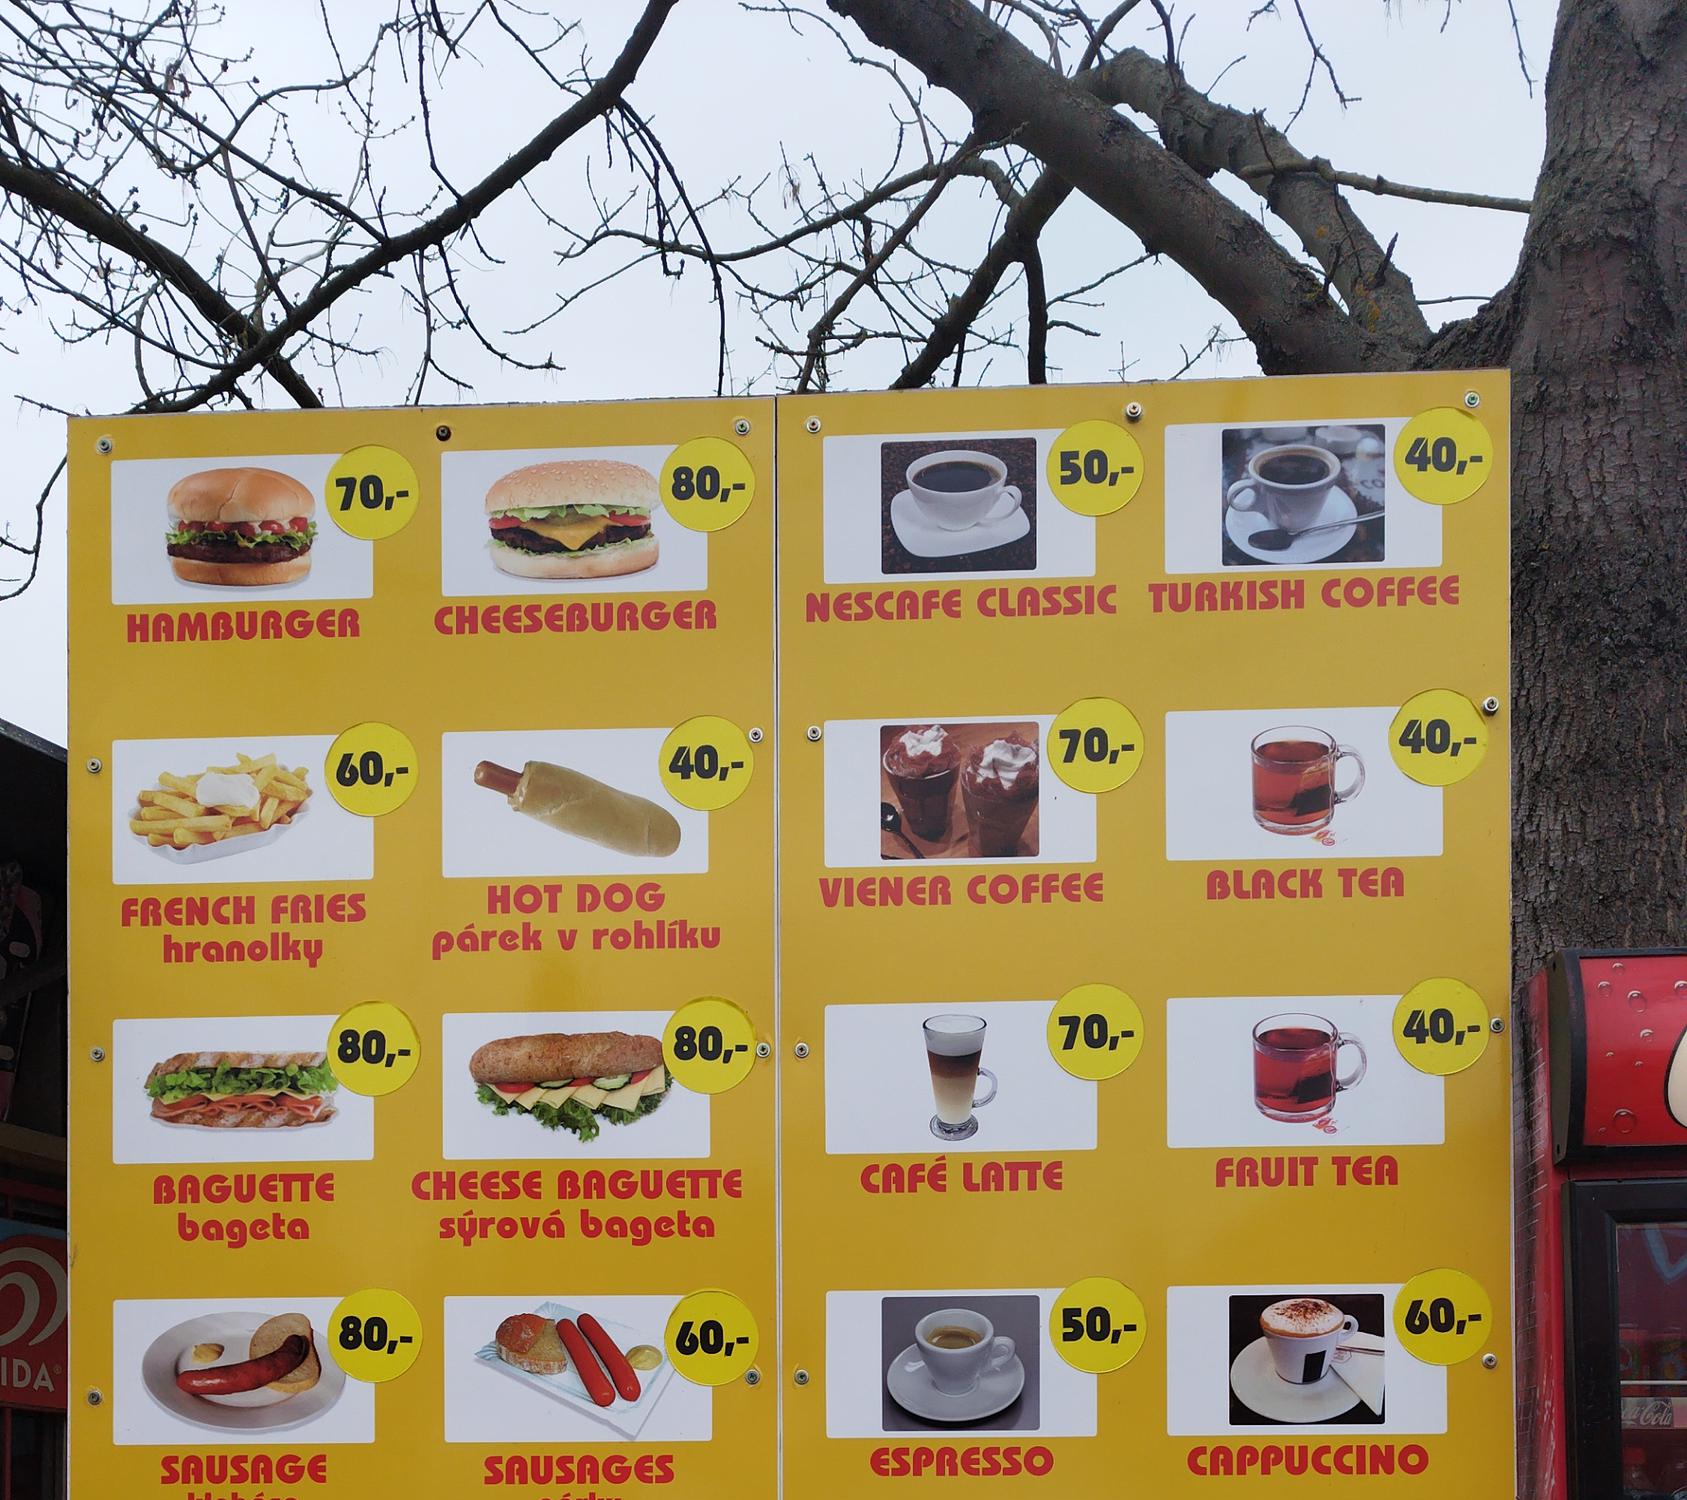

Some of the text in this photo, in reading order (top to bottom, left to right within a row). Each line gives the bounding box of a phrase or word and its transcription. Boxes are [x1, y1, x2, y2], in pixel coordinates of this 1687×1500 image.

[1060, 449, 1135, 487] 50,-
[1404, 436, 1483, 475] 40,-
[335, 474, 410, 512] 70,-
[671, 465, 746, 503] 80,-
[807, 586, 1115, 621] NESCAFE CLASSIC
[1151, 576, 1457, 611] TURKISH COFFEE
[127, 609, 360, 643] HAMBURGER
[435, 600, 716, 635] CHEESEBURGER
[1058, 727, 1135, 765] 70,-
[1398, 718, 1477, 757] 40,-
[335, 750, 409, 788] 60,-
[668, 744, 744, 782] 40,-
[488, 883, 664, 914] HOT DOG
[820, 874, 1102, 906] VIENER COFFEE
[1208, 868, 1403, 899] BLACK TEA
[122, 894, 365, 928] FRENCH FRIES
[163, 932, 323, 968] hranolky
[432, 920, 720, 960] párek v rohlíku
[673, 1025, 749, 1064] 80,-
[1058, 1013, 1135, 1051] 70,-
[1402, 1008, 1481, 1046] 40,-
[337, 1029, 411, 1068] 80,-
[153, 1172, 335, 1205] BAGUETTE
[411, 1168, 743, 1201] CHEESE BAGUETTE
[860, 1155, 1062, 1193] CAFÉ LATTE
[1215, 1155, 1398, 1187] FRUIT TEA
[178, 1212, 310, 1249] bageta
[439, 1208, 716, 1247] sýrová bageta
[338, 1315, 414, 1355] 80,-
[1062, 1306, 1138, 1345] 50,-
[1404, 1297, 1482, 1336] 60,-
[675, 1319, 750, 1357] 60,-
[160, 1454, 327, 1485] SAUSAGE
[483, 1454, 675, 1486] SAUSAGES
[869, 1446, 1053, 1477] ESPRESSO
[1187, 1444, 1429, 1477] CAPPUCCINO
